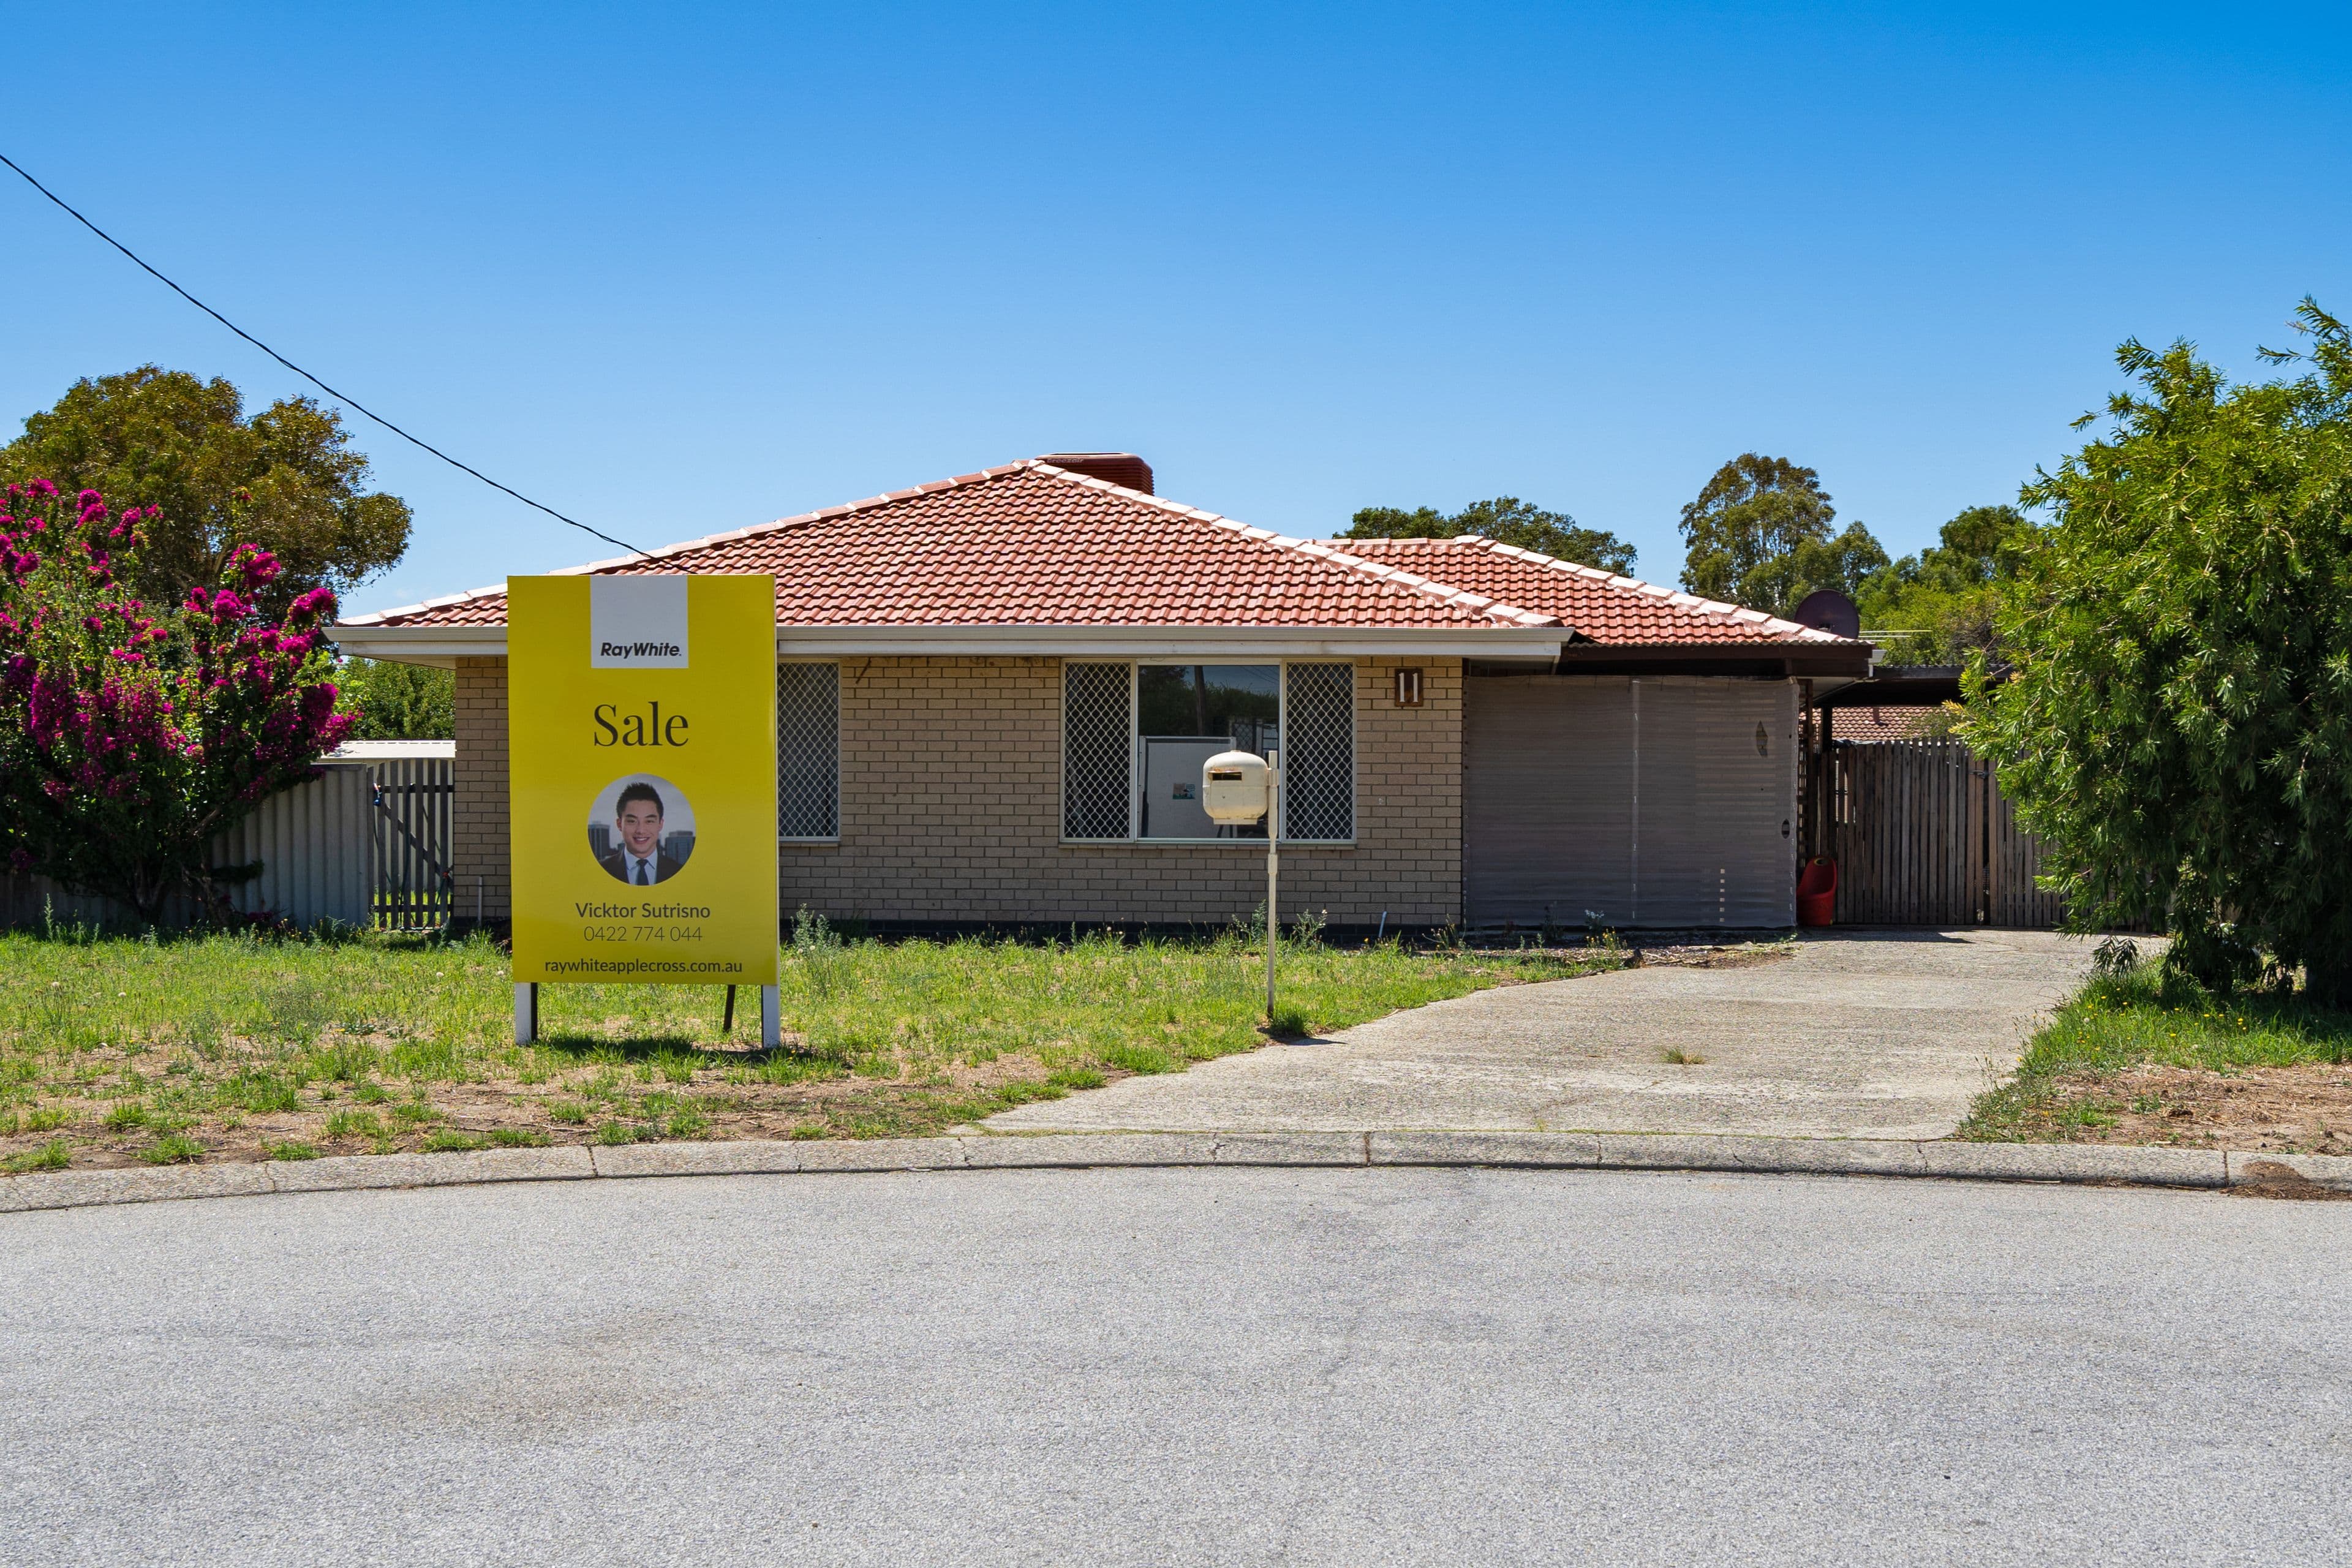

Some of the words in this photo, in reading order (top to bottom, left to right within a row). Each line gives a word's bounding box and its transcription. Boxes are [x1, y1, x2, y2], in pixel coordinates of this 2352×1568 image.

[1398, 672, 1419, 703] 11
[593, 701, 689, 747] Sale
[575, 902, 636, 918] Vicktor
[641, 902, 711, 918] Sutrisno
[584, 926, 627, 942] 0422
[633, 926, 665, 942] 774
[669, 926, 703, 942] 044
[545, 958, 743, 974] raywhiteapplecross.com.au
